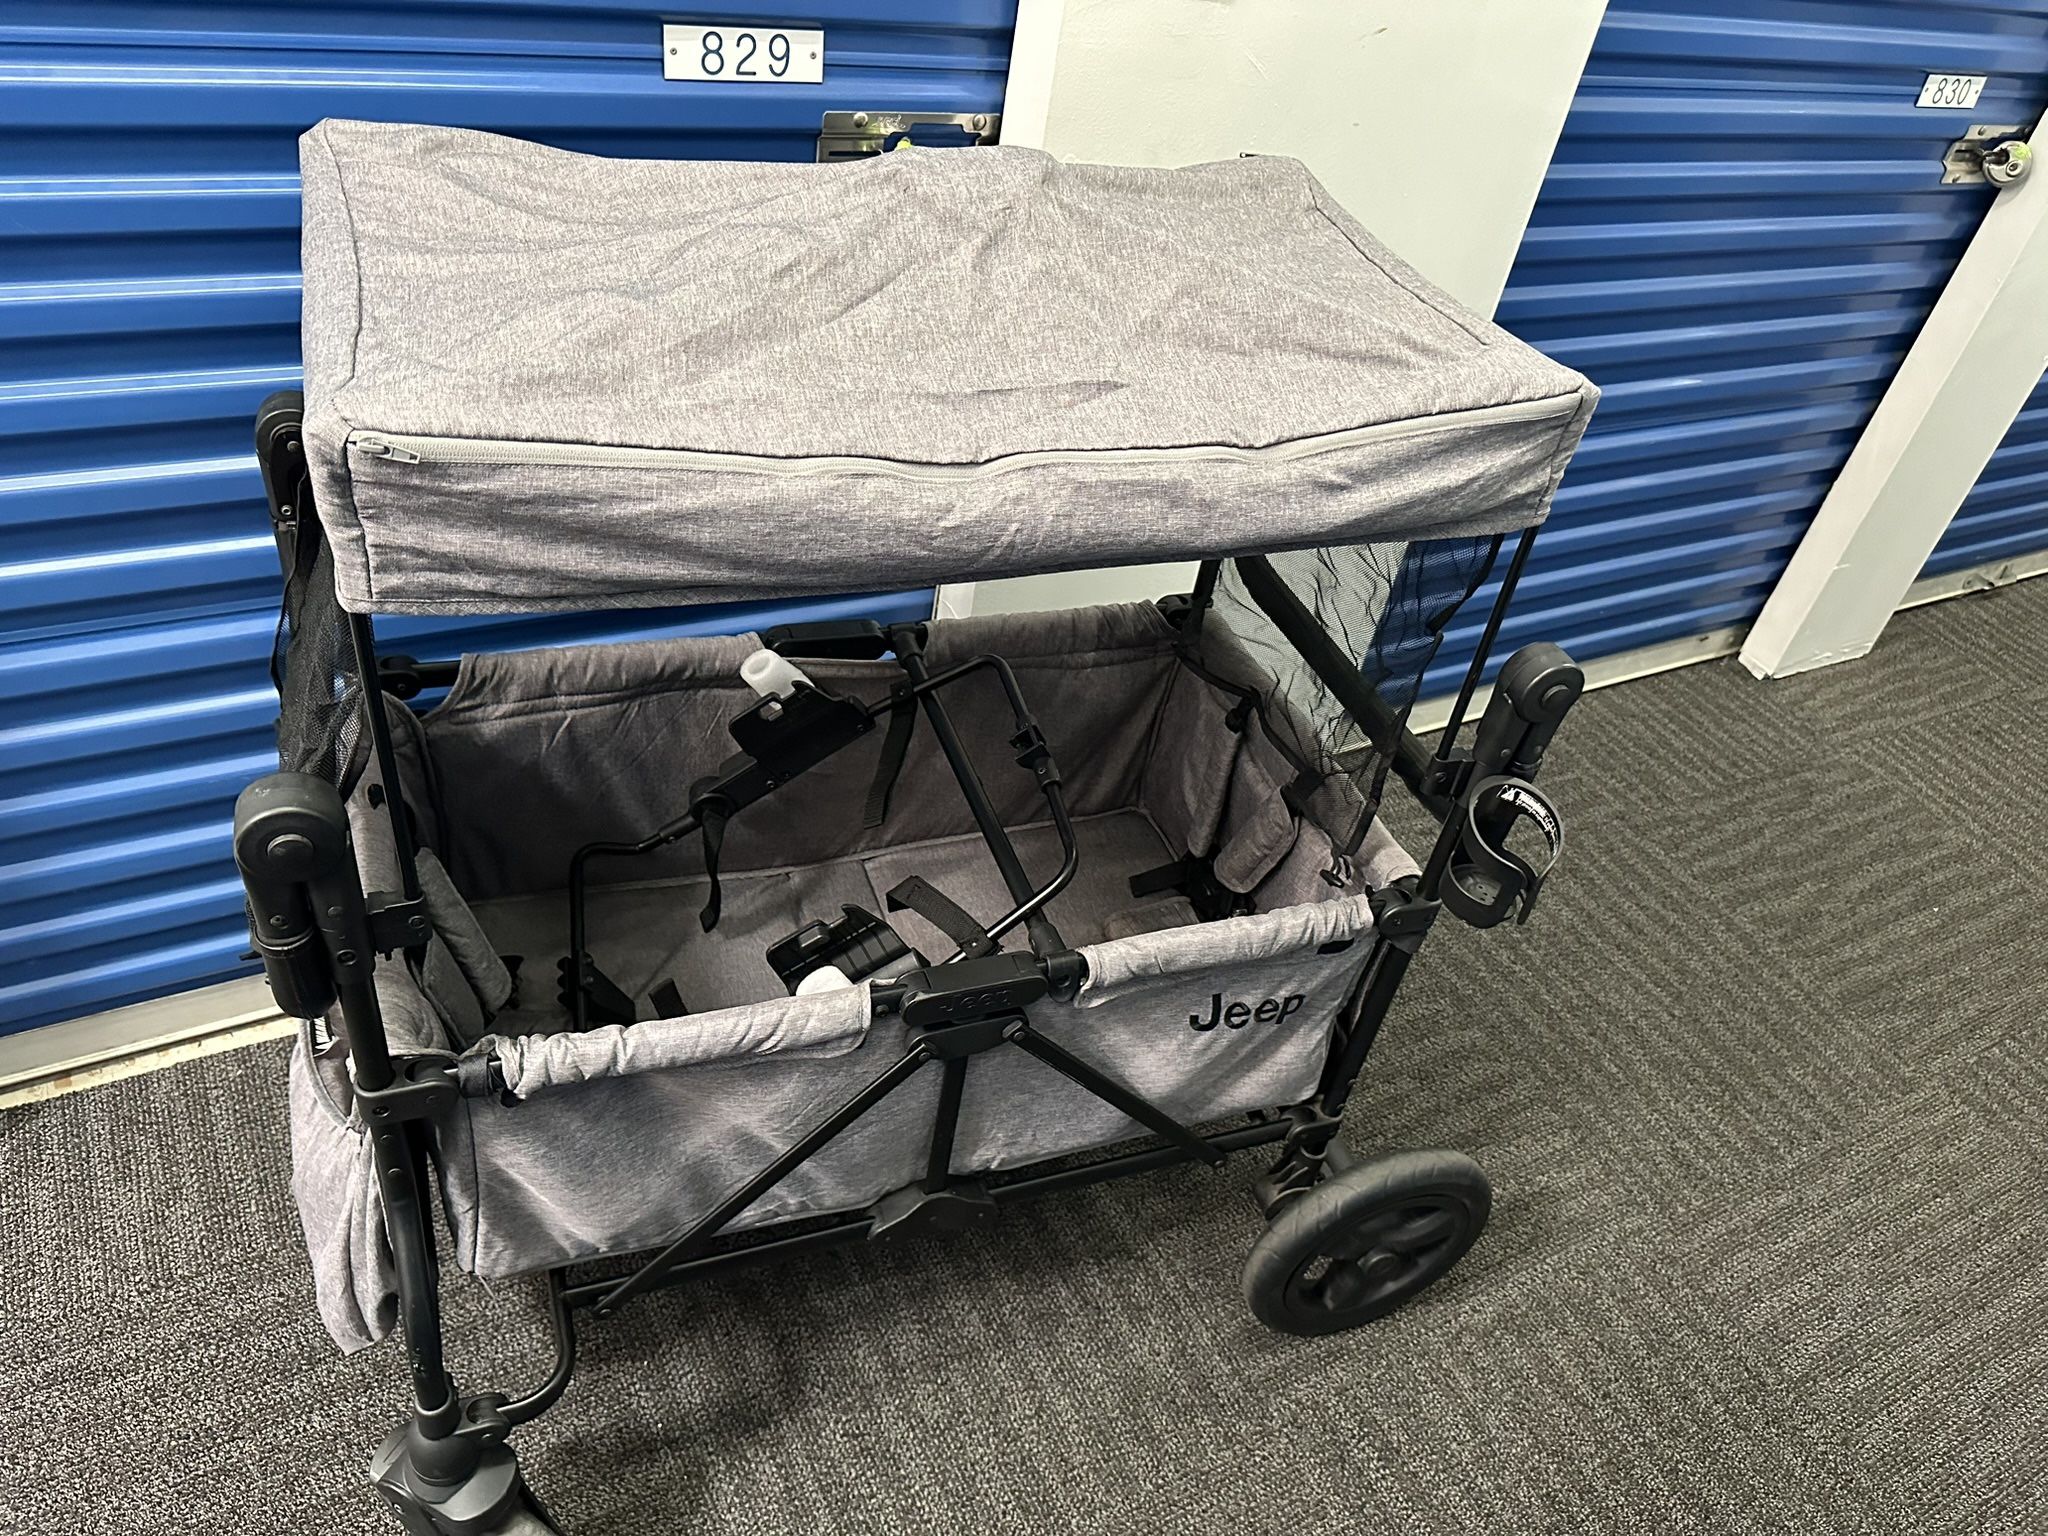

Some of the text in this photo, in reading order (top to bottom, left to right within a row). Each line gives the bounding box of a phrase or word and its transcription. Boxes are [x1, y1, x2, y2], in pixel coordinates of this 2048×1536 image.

[701, 31, 790, 77] 829
[1932, 78, 1972, 105] 830
[1189, 993, 1306, 1032] Jeep
